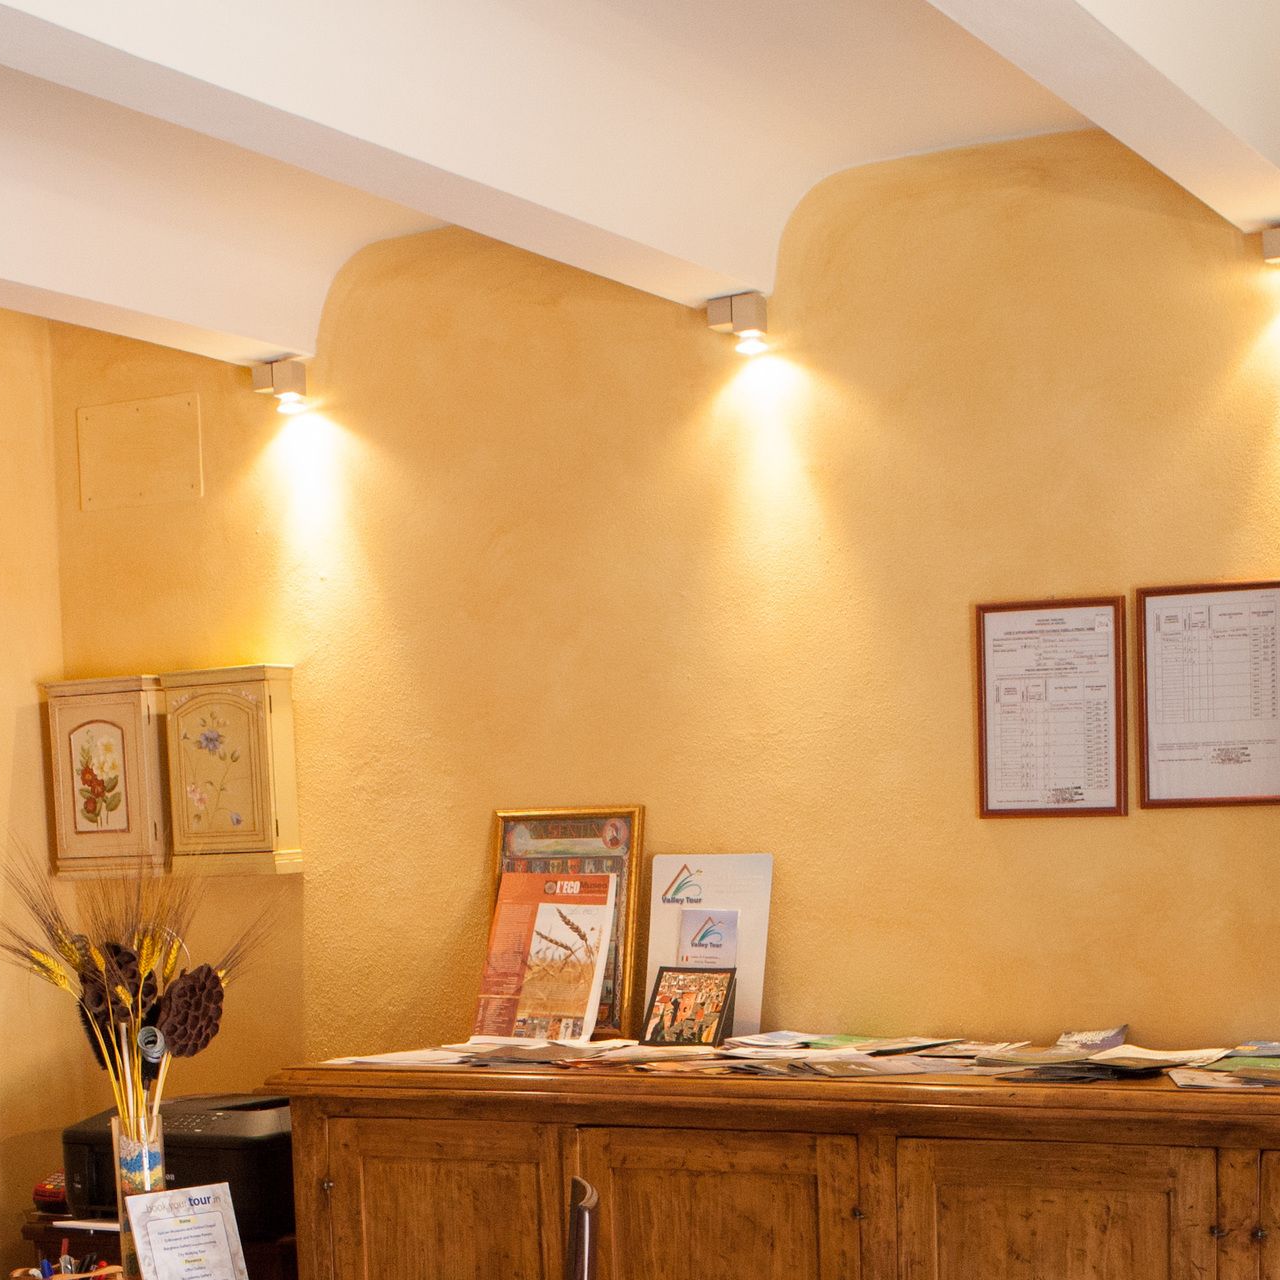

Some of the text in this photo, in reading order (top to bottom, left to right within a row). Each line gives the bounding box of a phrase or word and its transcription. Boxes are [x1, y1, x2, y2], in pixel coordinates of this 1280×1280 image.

[661, 896, 702, 905] Valley Tour
[188, 1195, 212, 1207] tour
